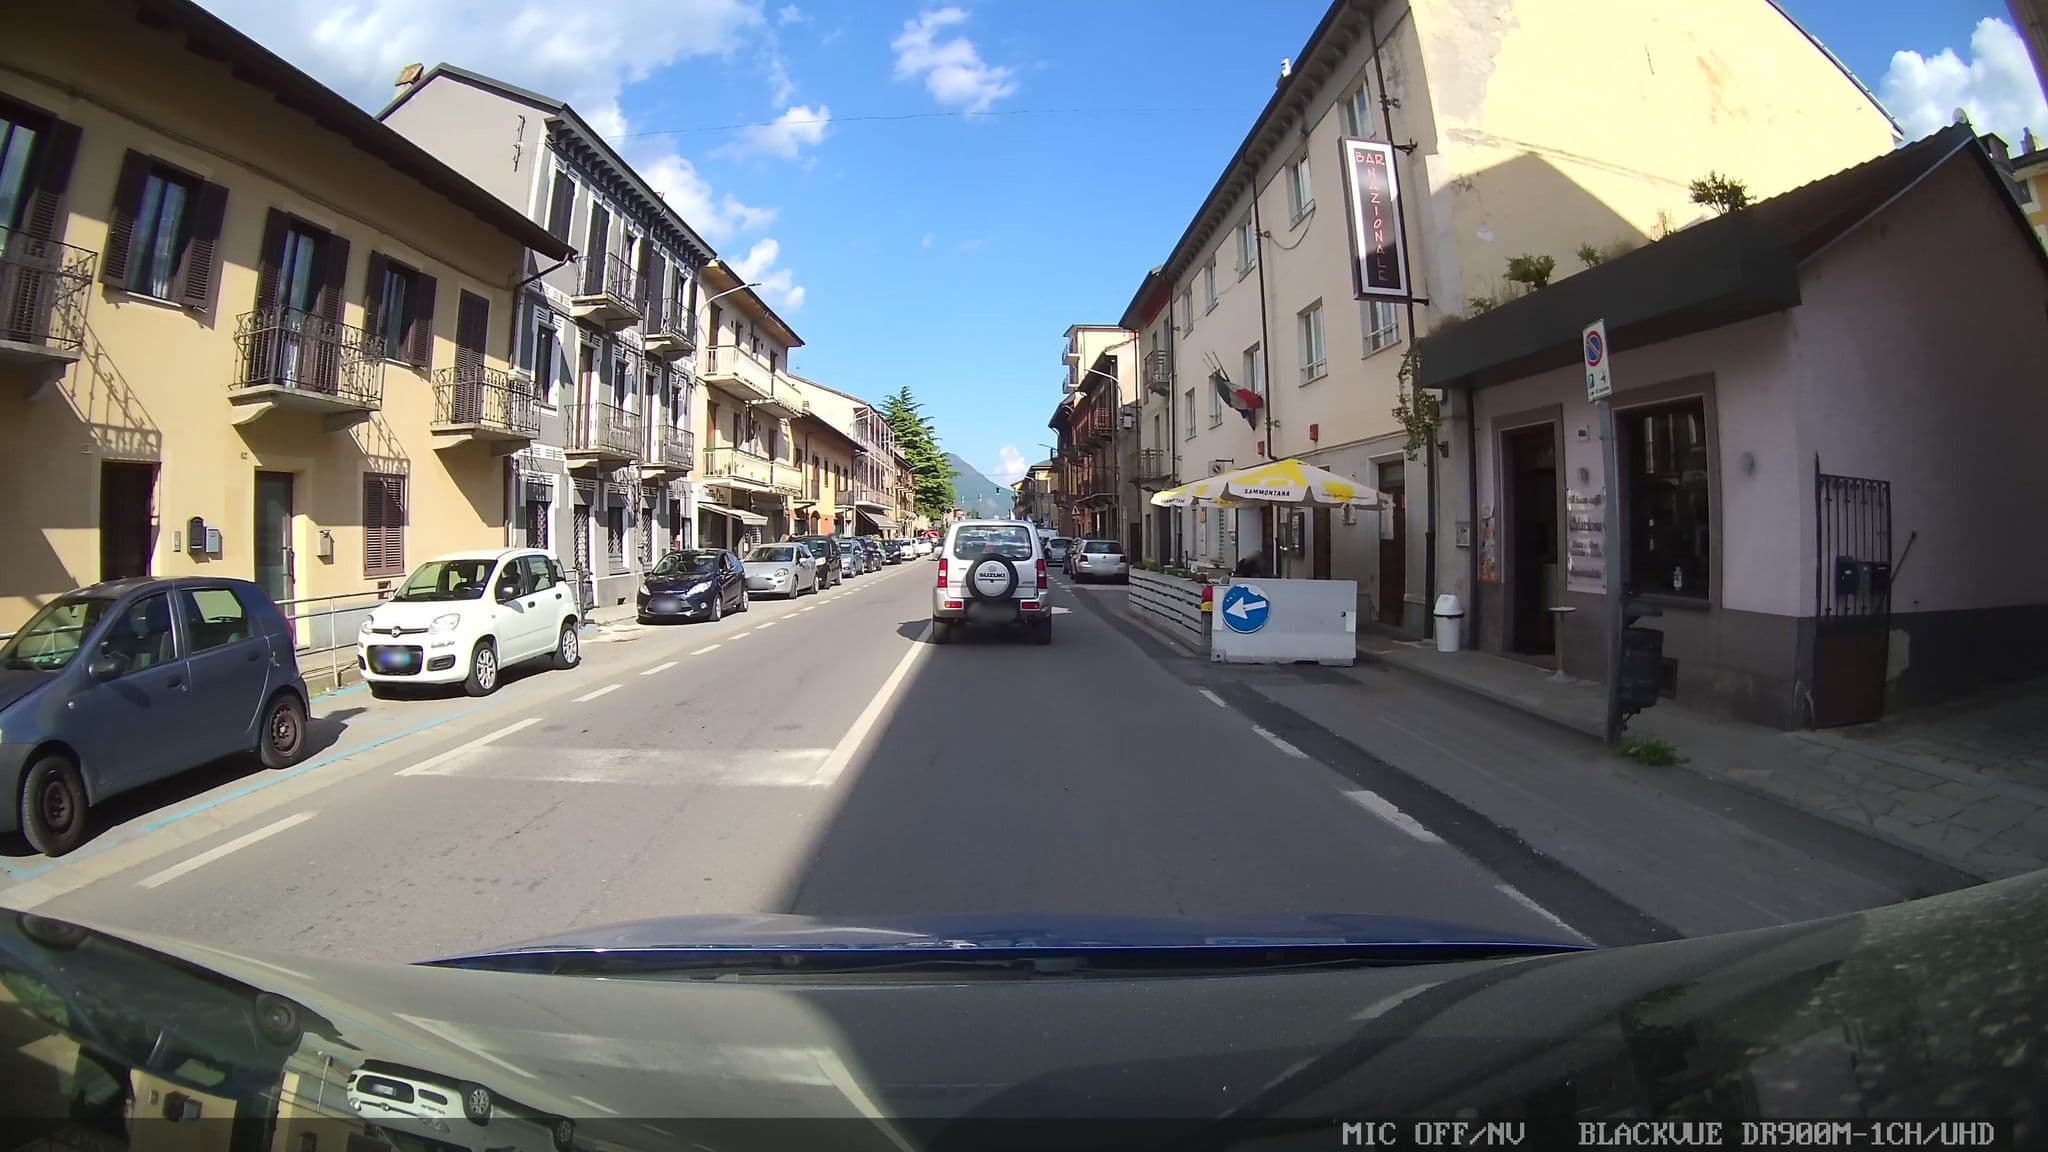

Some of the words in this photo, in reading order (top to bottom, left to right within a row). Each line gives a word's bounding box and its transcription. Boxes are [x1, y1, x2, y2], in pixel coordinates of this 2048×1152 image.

[1355, 152, 1385, 165] BAR
[1368, 169, 1388, 281] NAZIONALE
[1244, 489, 1290, 497] SAMMONTANA
